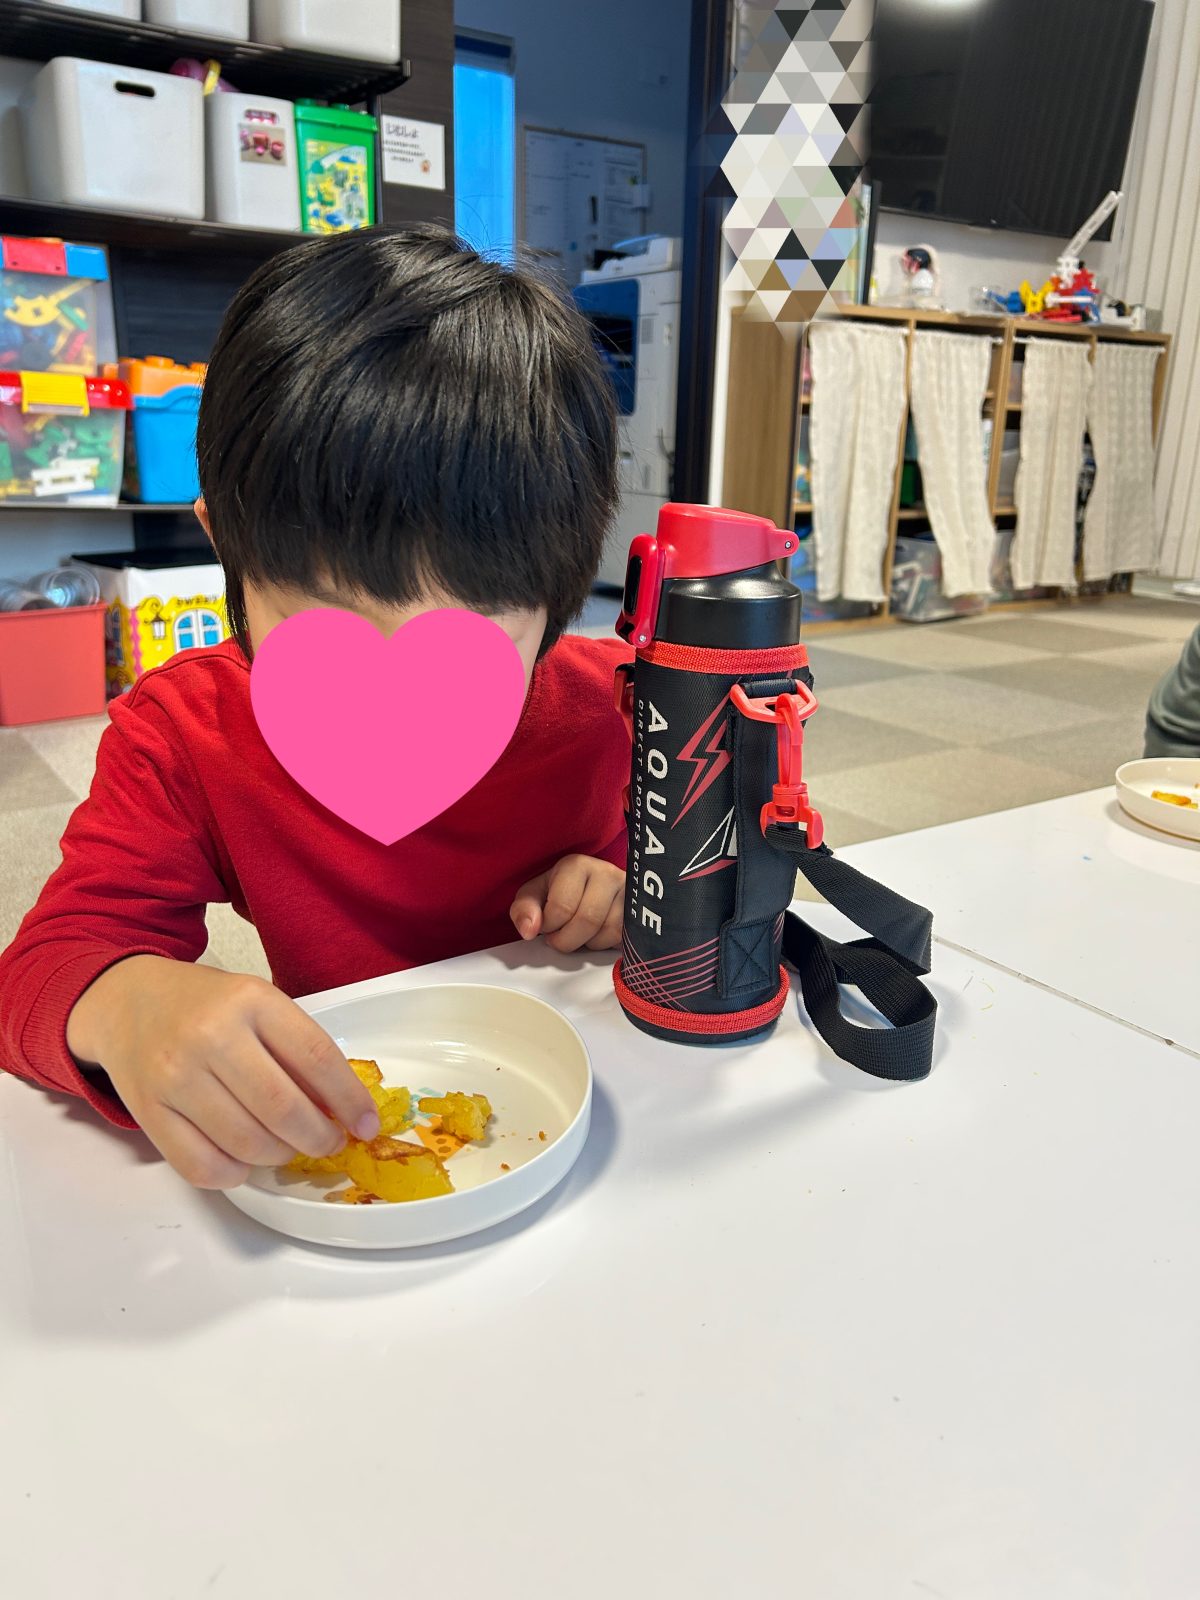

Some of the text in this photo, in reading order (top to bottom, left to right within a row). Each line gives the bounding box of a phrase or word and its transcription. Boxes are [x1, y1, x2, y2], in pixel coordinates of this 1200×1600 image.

[634, 773, 643, 841] SPORTS
[641, 700, 669, 936] AQUAGE
[631, 849, 640, 919] BOTTLE
